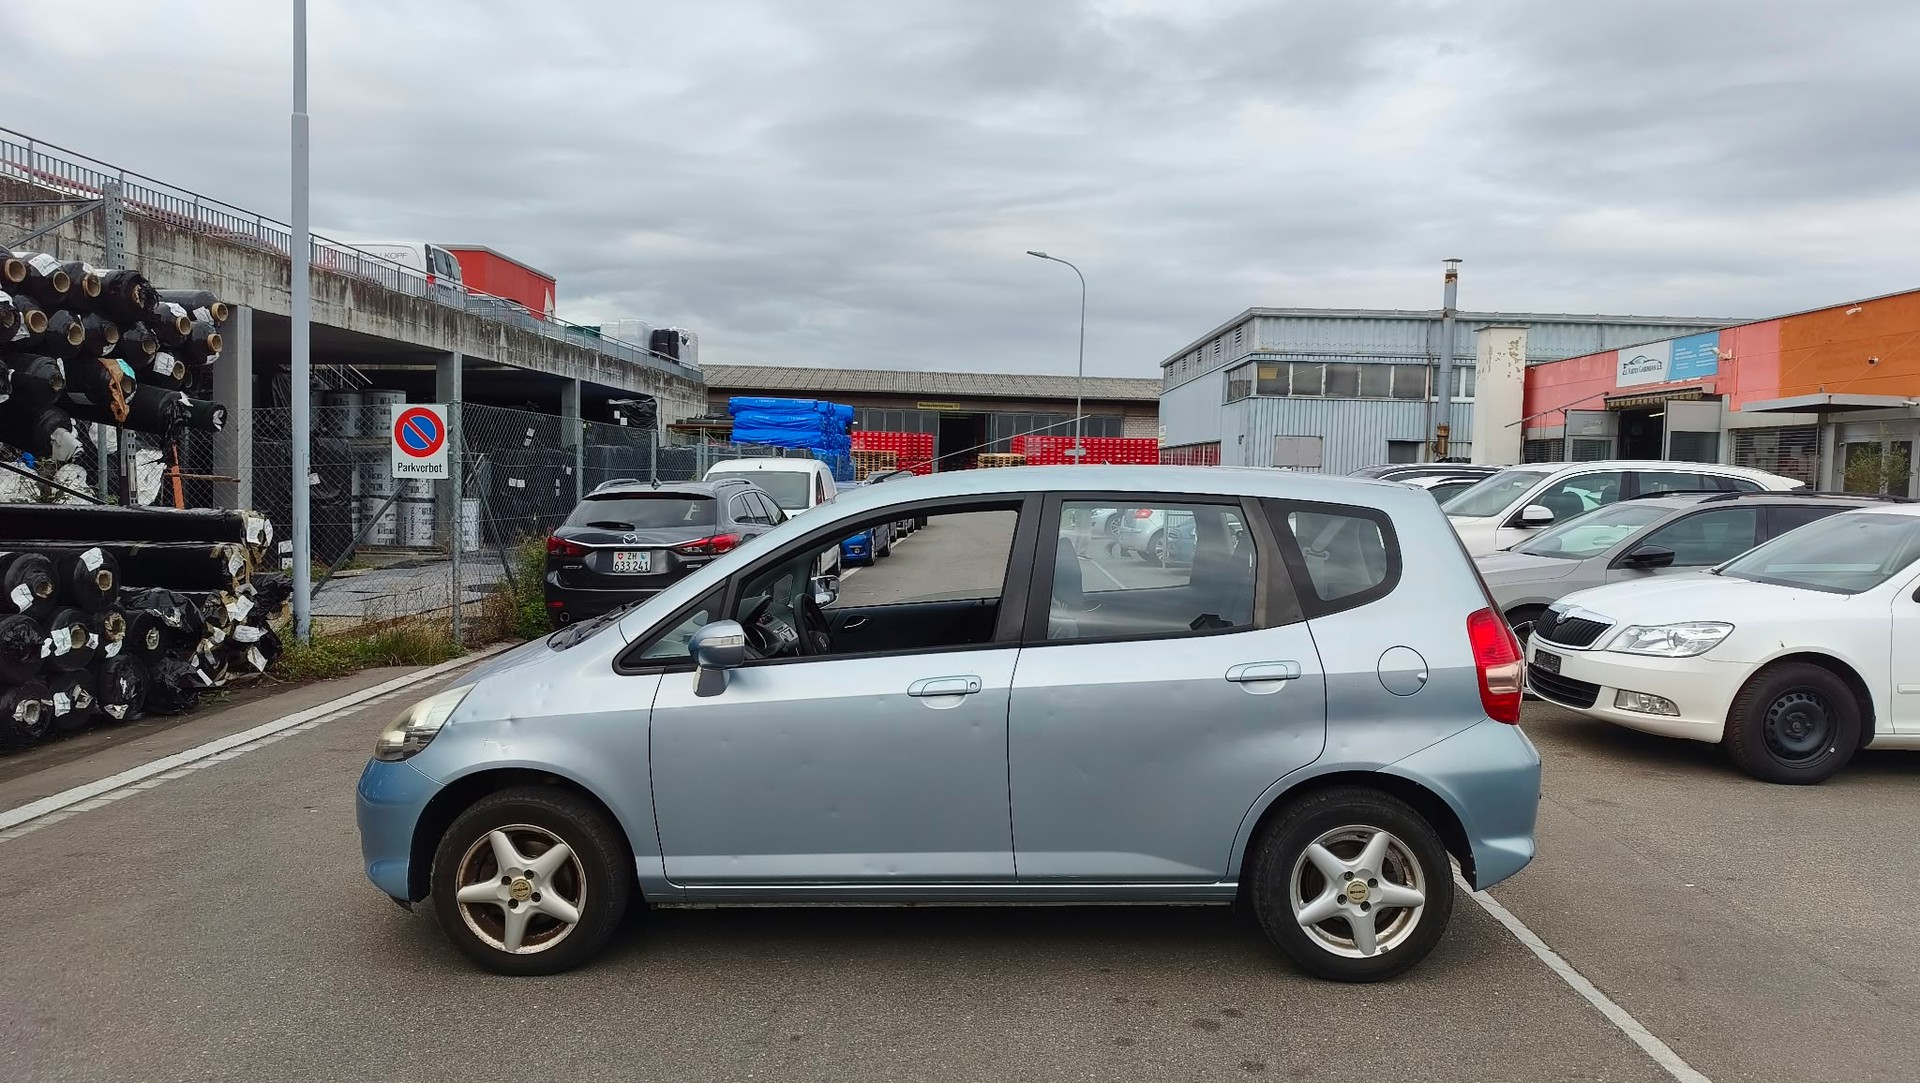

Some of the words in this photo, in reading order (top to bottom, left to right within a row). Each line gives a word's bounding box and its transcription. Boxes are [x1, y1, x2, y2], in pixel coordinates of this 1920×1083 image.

[397, 462, 443, 473] Parkverbot
[627, 552, 637, 560] ZH
[614, 561, 631, 571] 633
[632, 561, 649, 571] 241
